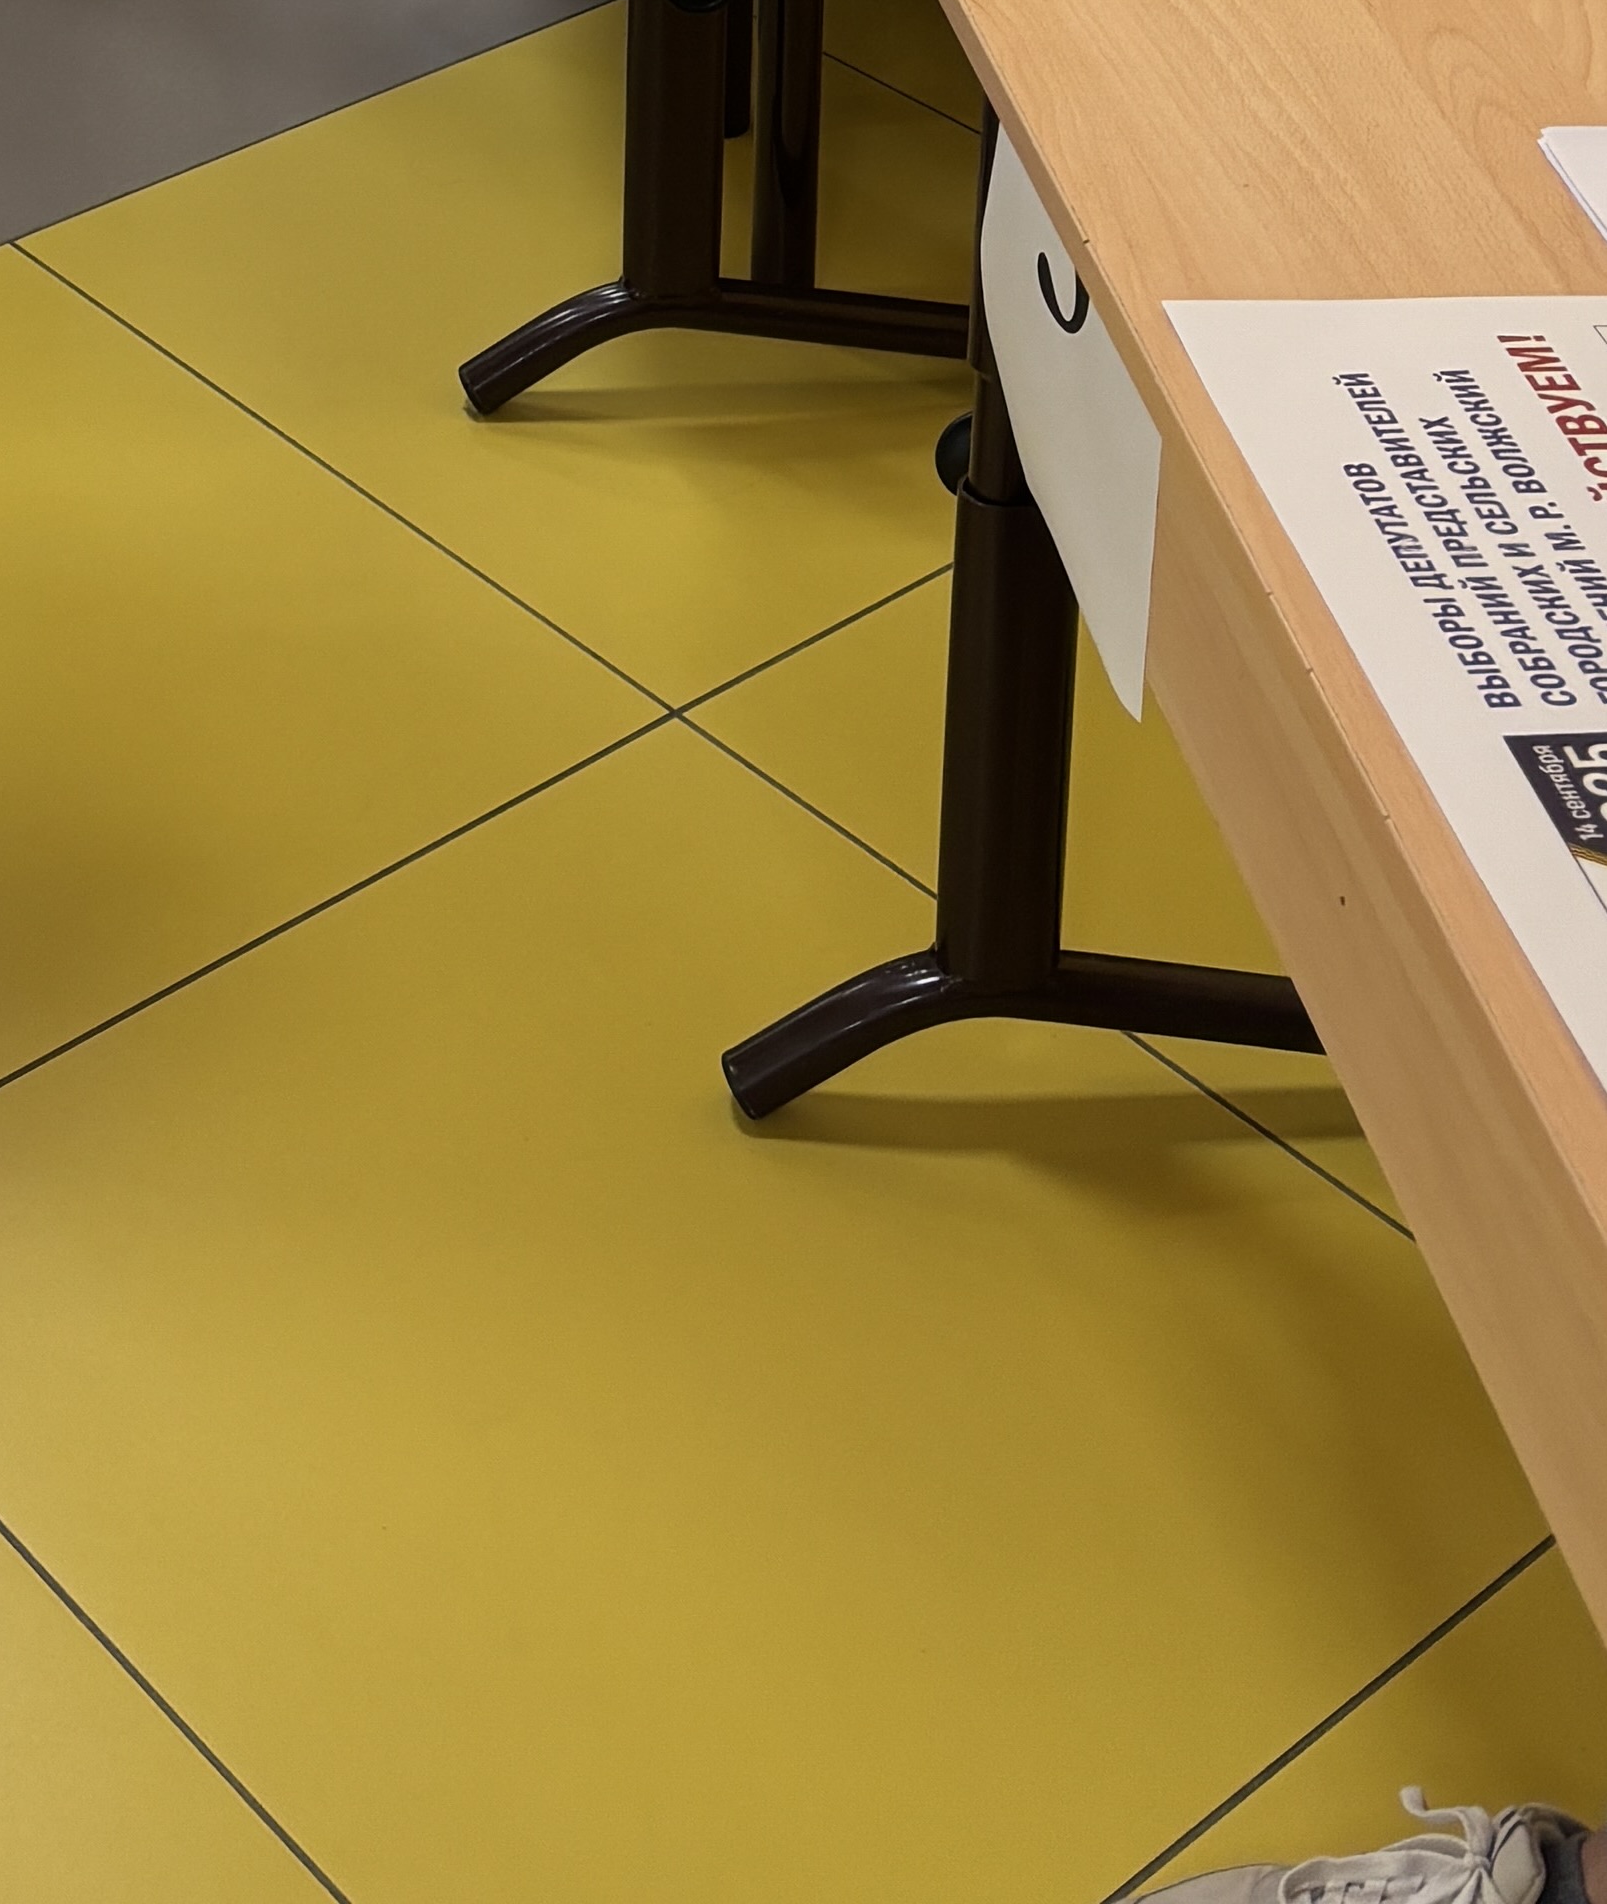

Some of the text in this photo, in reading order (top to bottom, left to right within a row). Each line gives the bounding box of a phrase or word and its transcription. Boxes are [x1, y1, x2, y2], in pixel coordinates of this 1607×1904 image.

[1432, 369, 1548, 494] ВОЛЖСКИЙ
[1418, 415, 1520, 537] СЕЛЬСКИХ
[1528, 501, 1565, 520] Р.
[1332, 372, 1578, 707] СОБРАНИЙ ПРЕДСТАВИТЕЛЕЙ
[1497, 543, 1536, 558] И
[1543, 524, 1586, 552] М.
[1343, 462, 1523, 709] ВЫБОРЫ ДЕПУТАТОВ
[1532, 744, 1592, 820] сентября
[1574, 823, 1604, 841] 14
